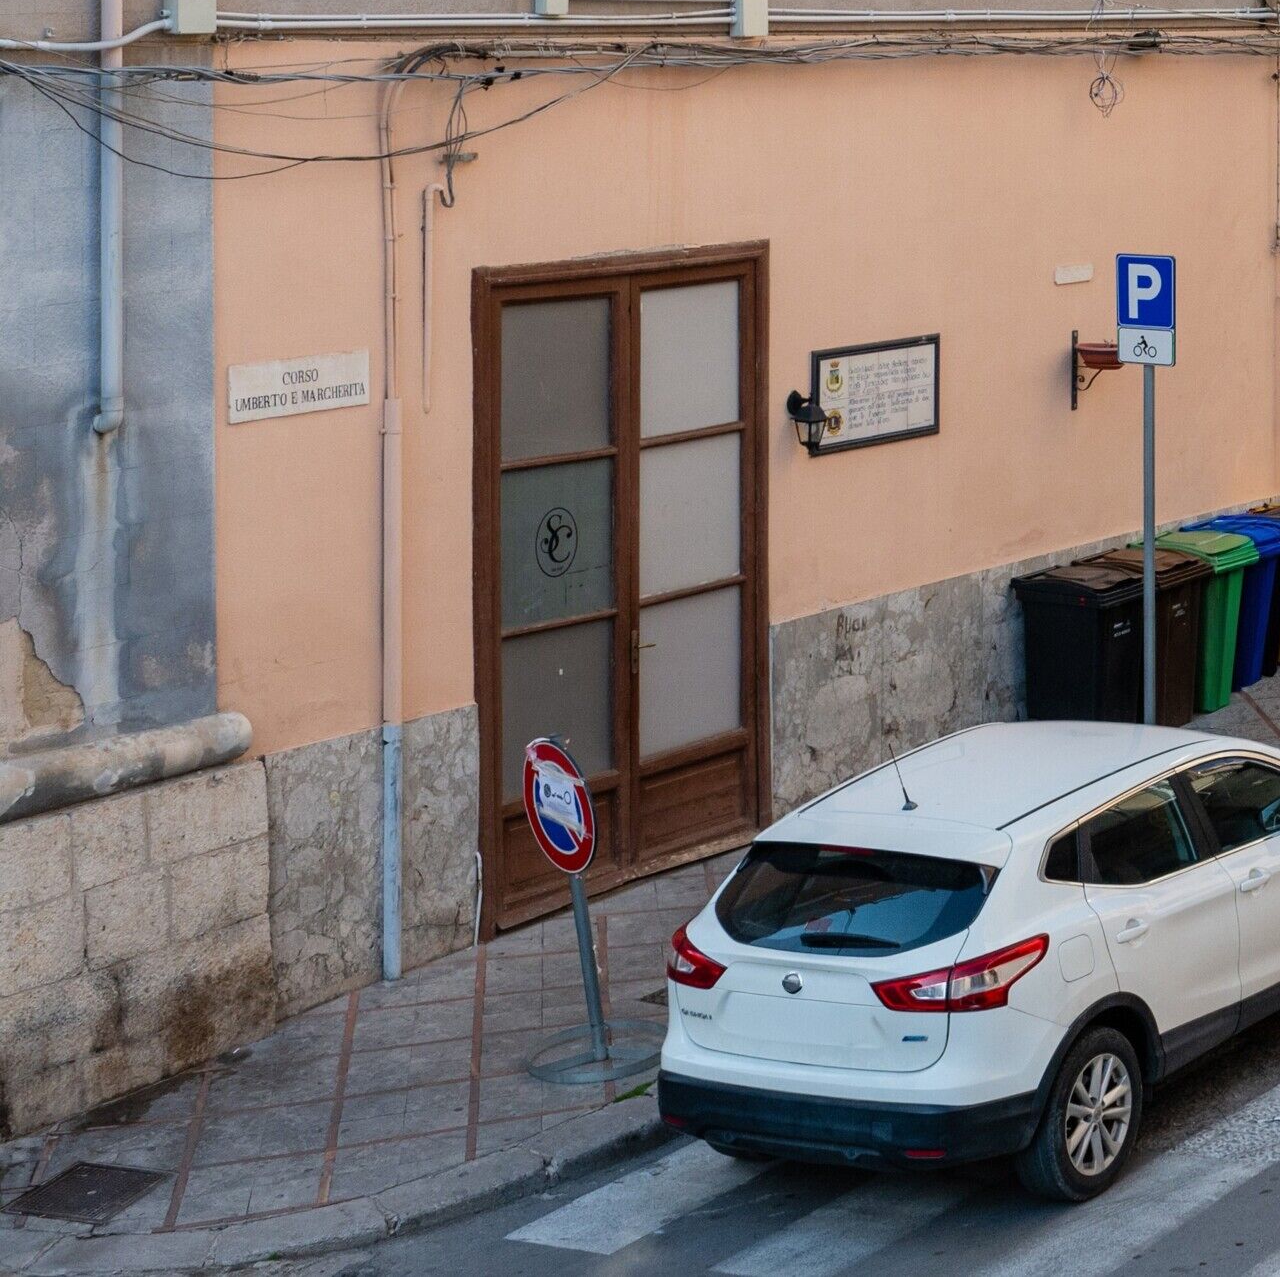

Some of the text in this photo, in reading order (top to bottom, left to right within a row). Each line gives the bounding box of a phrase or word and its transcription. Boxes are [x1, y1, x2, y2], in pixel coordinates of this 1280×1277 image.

[1128, 263, 1162, 319] P
[282, 368, 319, 385] CORSO
[235, 382, 366, 412] UMBERTO E MARGHERITA
